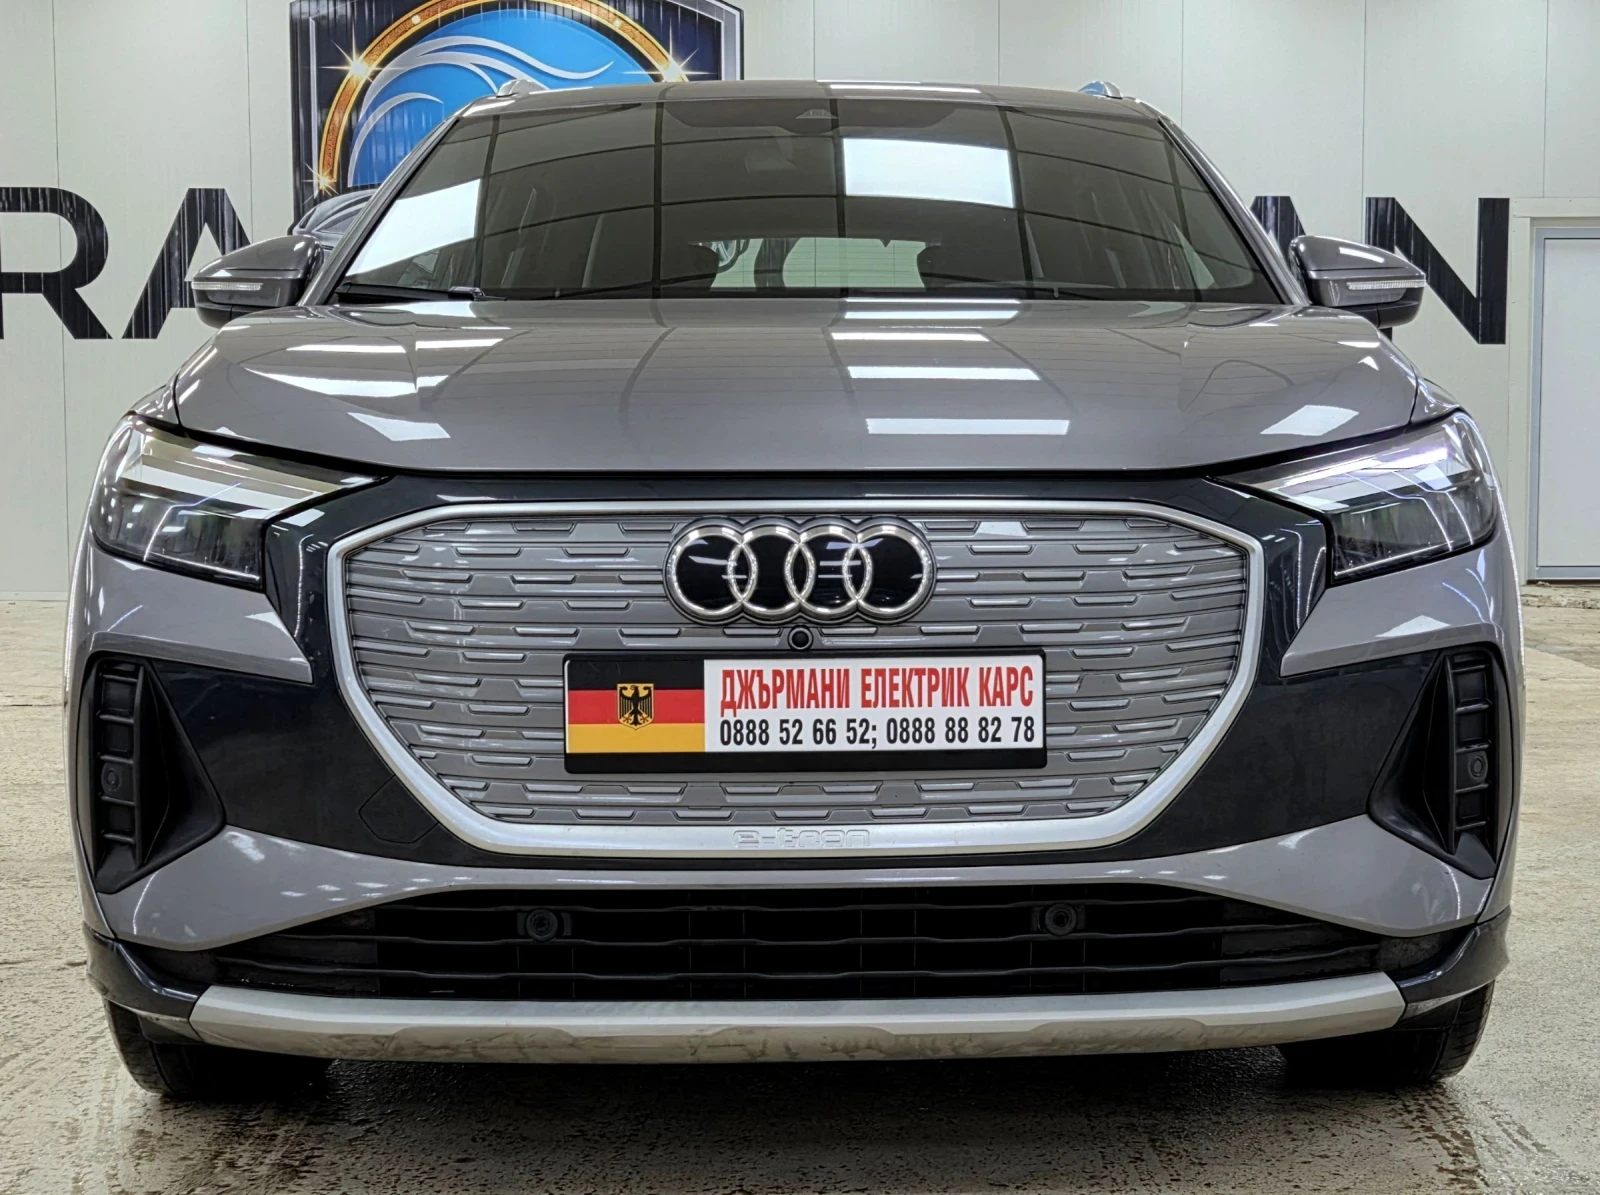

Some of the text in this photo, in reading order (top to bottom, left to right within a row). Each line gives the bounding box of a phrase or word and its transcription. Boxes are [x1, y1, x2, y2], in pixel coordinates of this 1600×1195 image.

[720, 666, 1034, 717] ДЖЪРМАНИ ЕЛЕКТРИК КАРС
[720, 715, 1035, 749] 0888 52 66 52; 0888 88 82 78
[733, 827, 870, 848] e-tron
